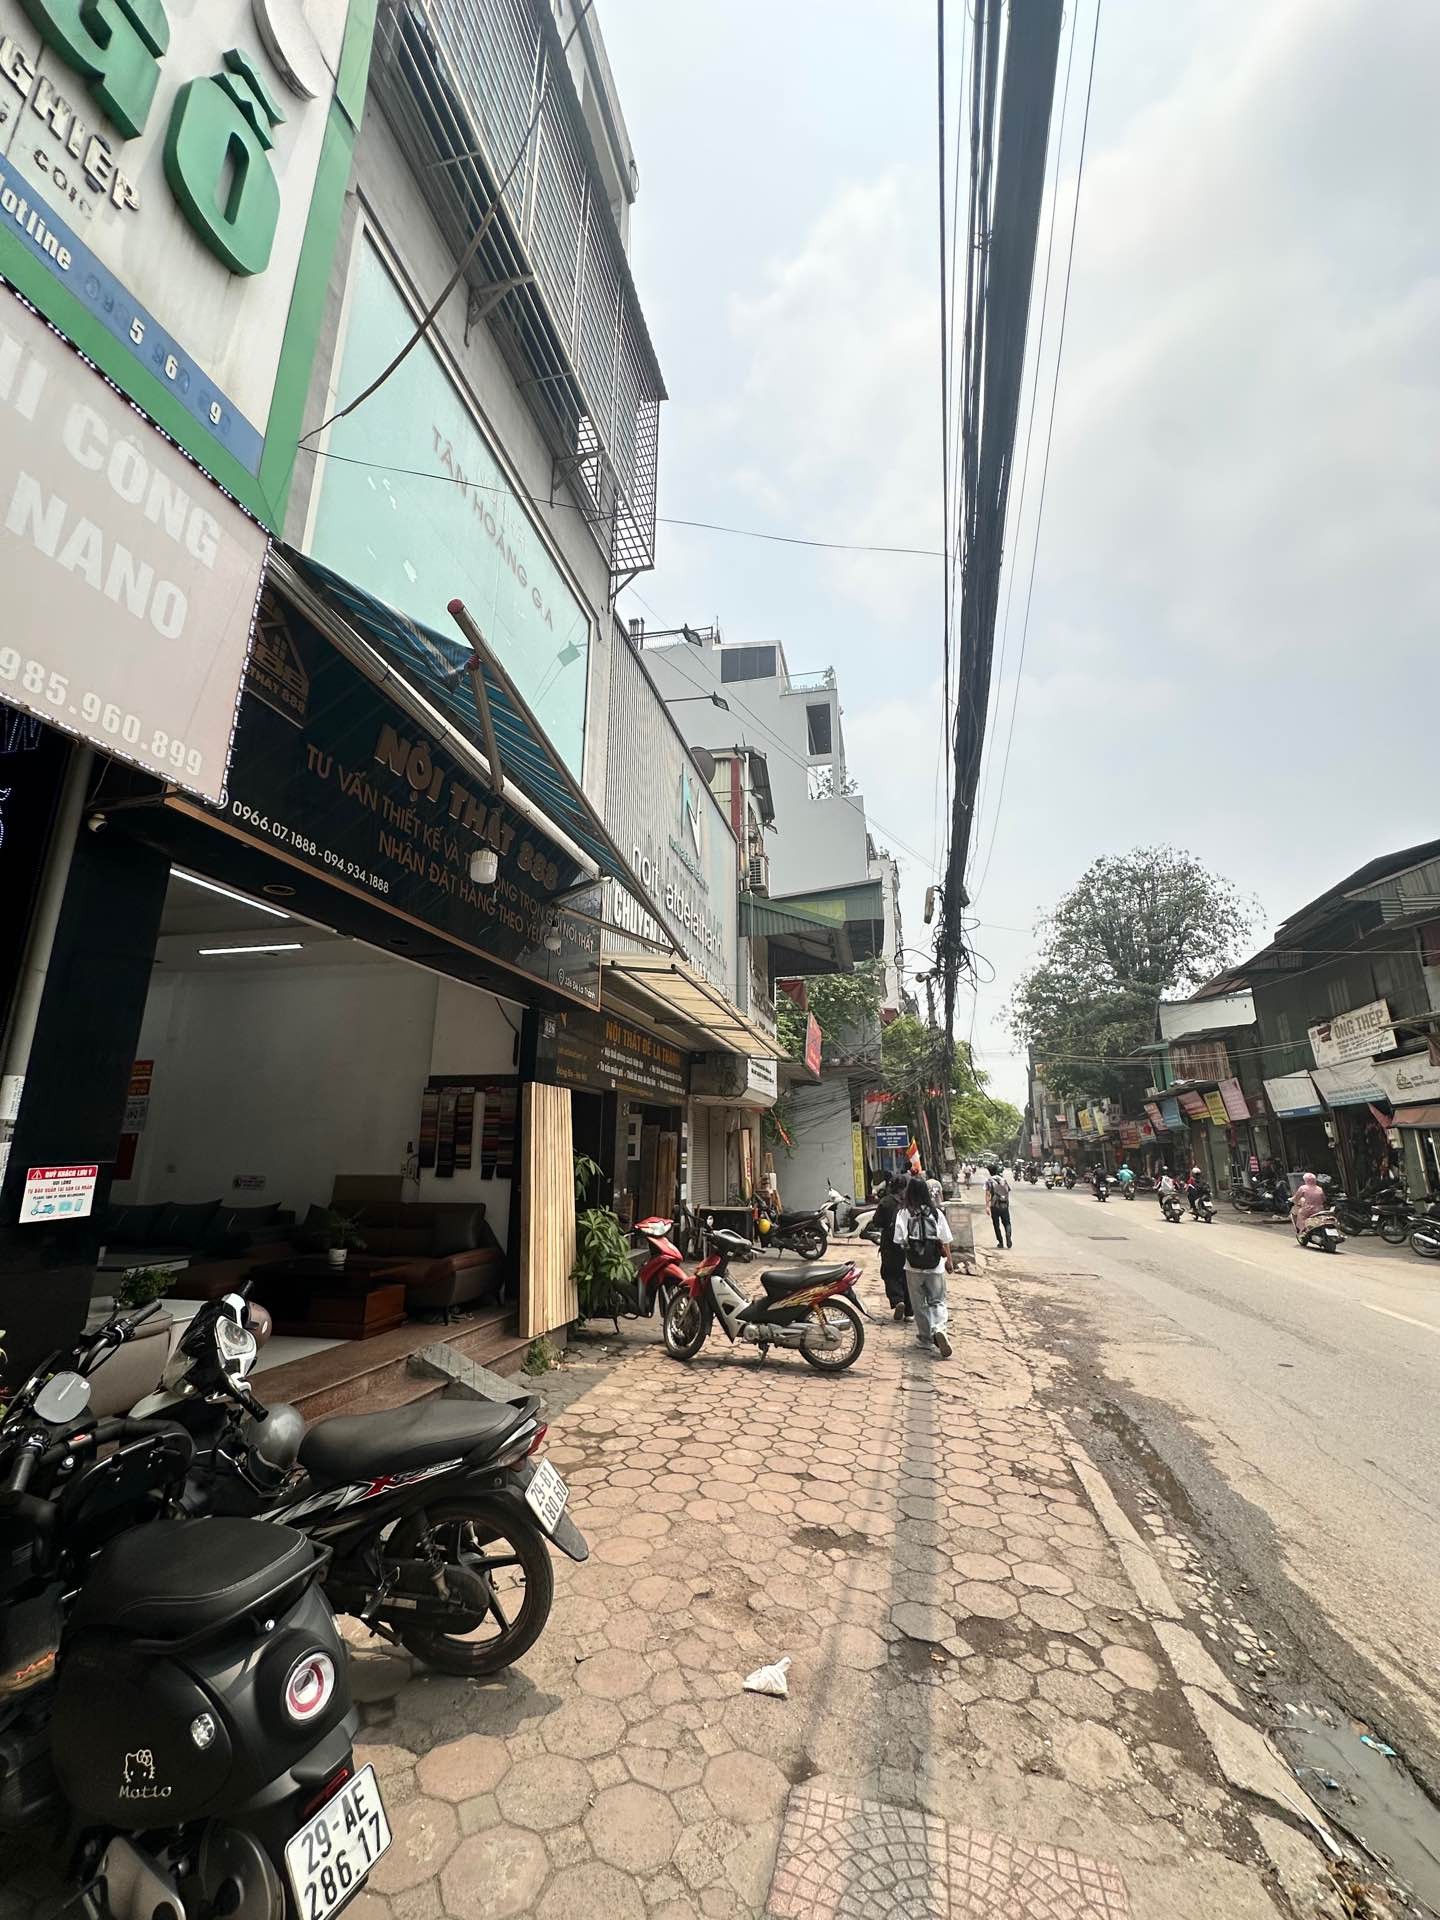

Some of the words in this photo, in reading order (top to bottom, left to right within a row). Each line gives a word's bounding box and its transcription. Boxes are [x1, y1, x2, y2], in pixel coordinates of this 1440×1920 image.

[0, 172, 71, 271] otline
[62, 400, 221, 569] CÔNG
[4, 472, 188, 640] NANO
[473, 490, 528, 587] HOÀNG
[338, 765, 378, 812] VẤN
[382, 795, 422, 839] THIẾT
[423, 825, 444, 853] KẾ
[444, 832, 460, 866] VÀ
[374, 723, 445, 803] NỘI
[517, 840, 559, 891] 888
[378, 830, 426, 876] NHẬN
[459, 880, 496, 916] HÀNG
[498, 903, 524, 933] THEO
[1356, 1007, 1384, 1030] THÉP
[542, 1480, 567, 1526] 180.60
[301, 1781, 369, 1875] 29-AE
[304, 1810, 381, 1920] 286.17
